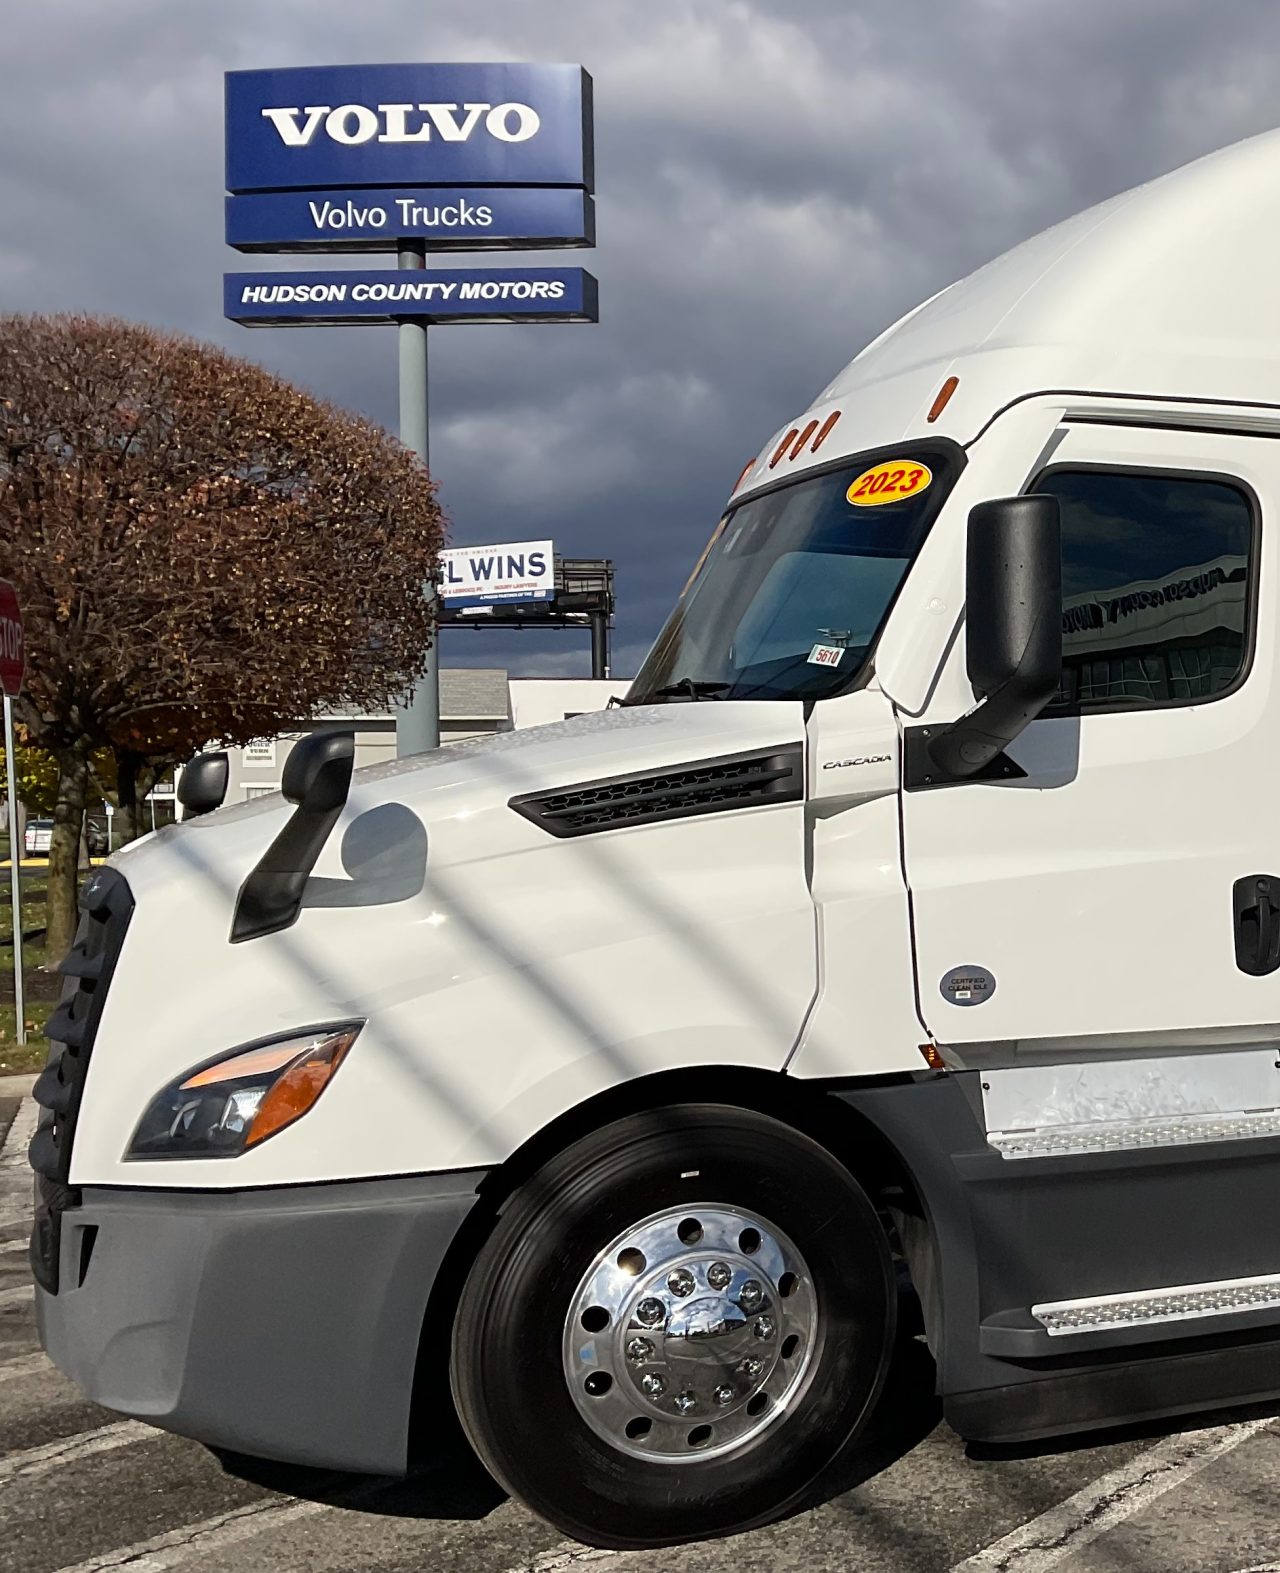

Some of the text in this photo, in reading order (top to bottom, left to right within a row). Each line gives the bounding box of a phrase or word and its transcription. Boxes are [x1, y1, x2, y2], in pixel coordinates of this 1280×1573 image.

[262, 102, 540, 146] VOLVO
[309, 199, 493, 229] Volvo Trucks
[241, 281, 565, 303] HUDSON COUNTY MOTORS
[852, 470, 924, 498] 2023
[469, 552, 546, 581] WINS
[816, 650, 839, 664] 5610
[823, 755, 892, 769] CASCADIA
